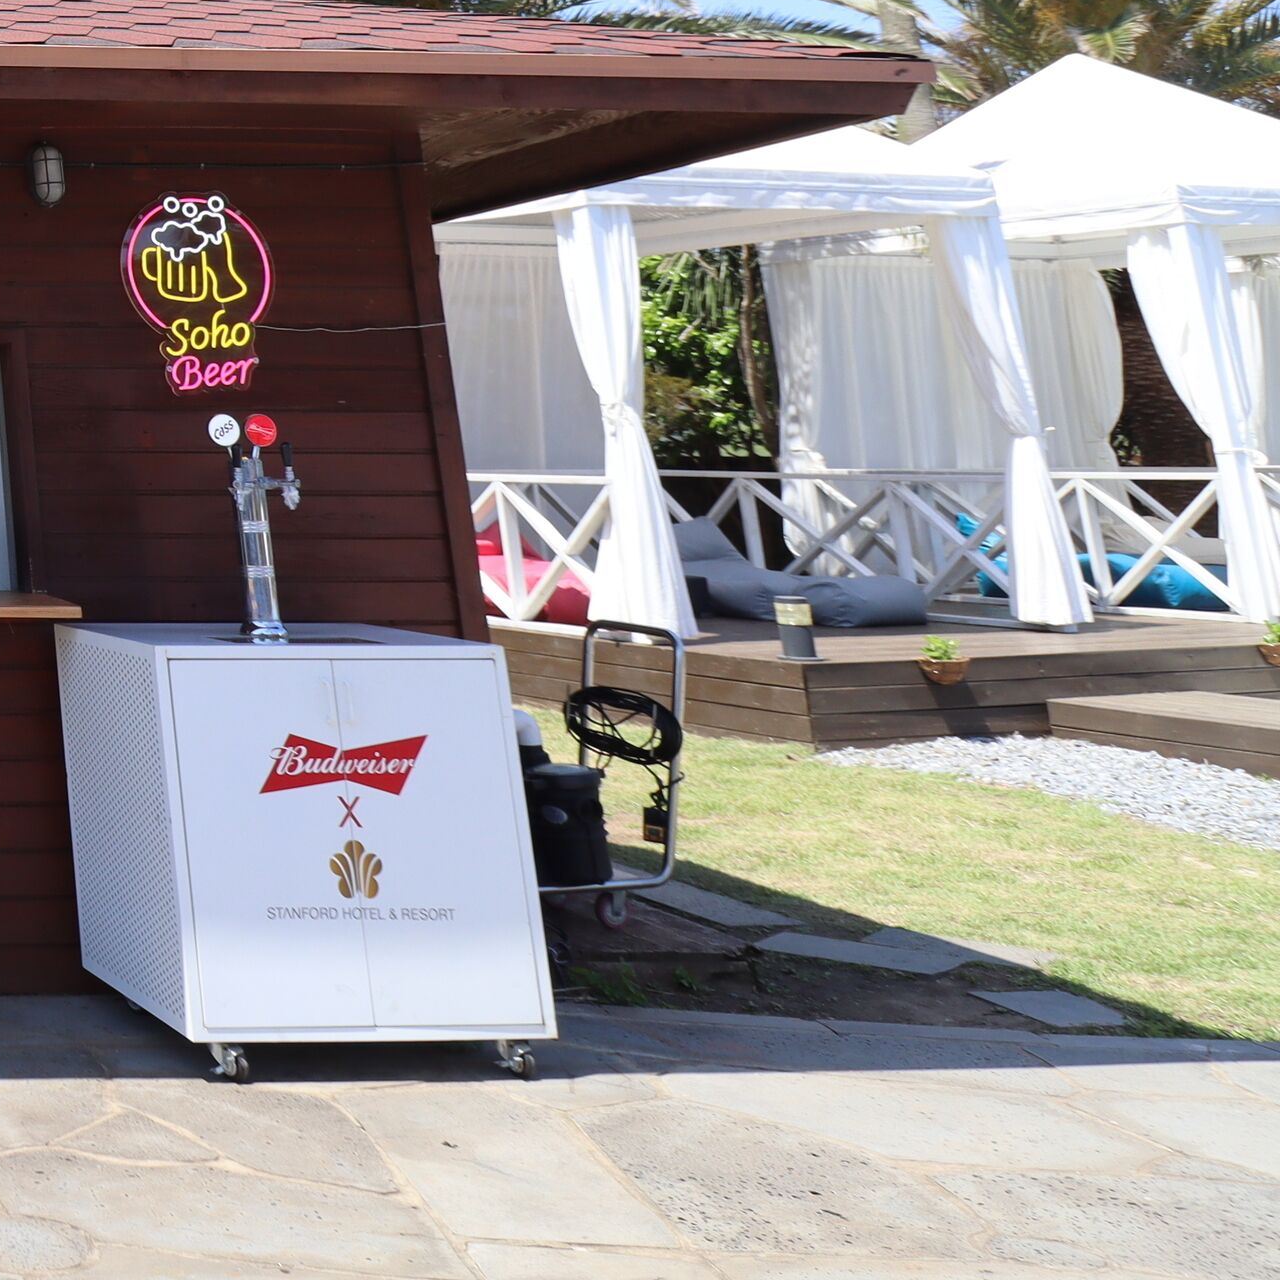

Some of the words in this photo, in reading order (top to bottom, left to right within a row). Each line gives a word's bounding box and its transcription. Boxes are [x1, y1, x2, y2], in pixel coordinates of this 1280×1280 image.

[165, 309, 251, 356] Soho
[171, 355, 255, 391] Beer
[270, 744, 415, 777] Budweiser
[266, 906, 339, 921] STANFORD
[341, 907, 386, 921] HOTEL
[388, 907, 398, 921] &
[400, 907, 456, 921] RESORT
